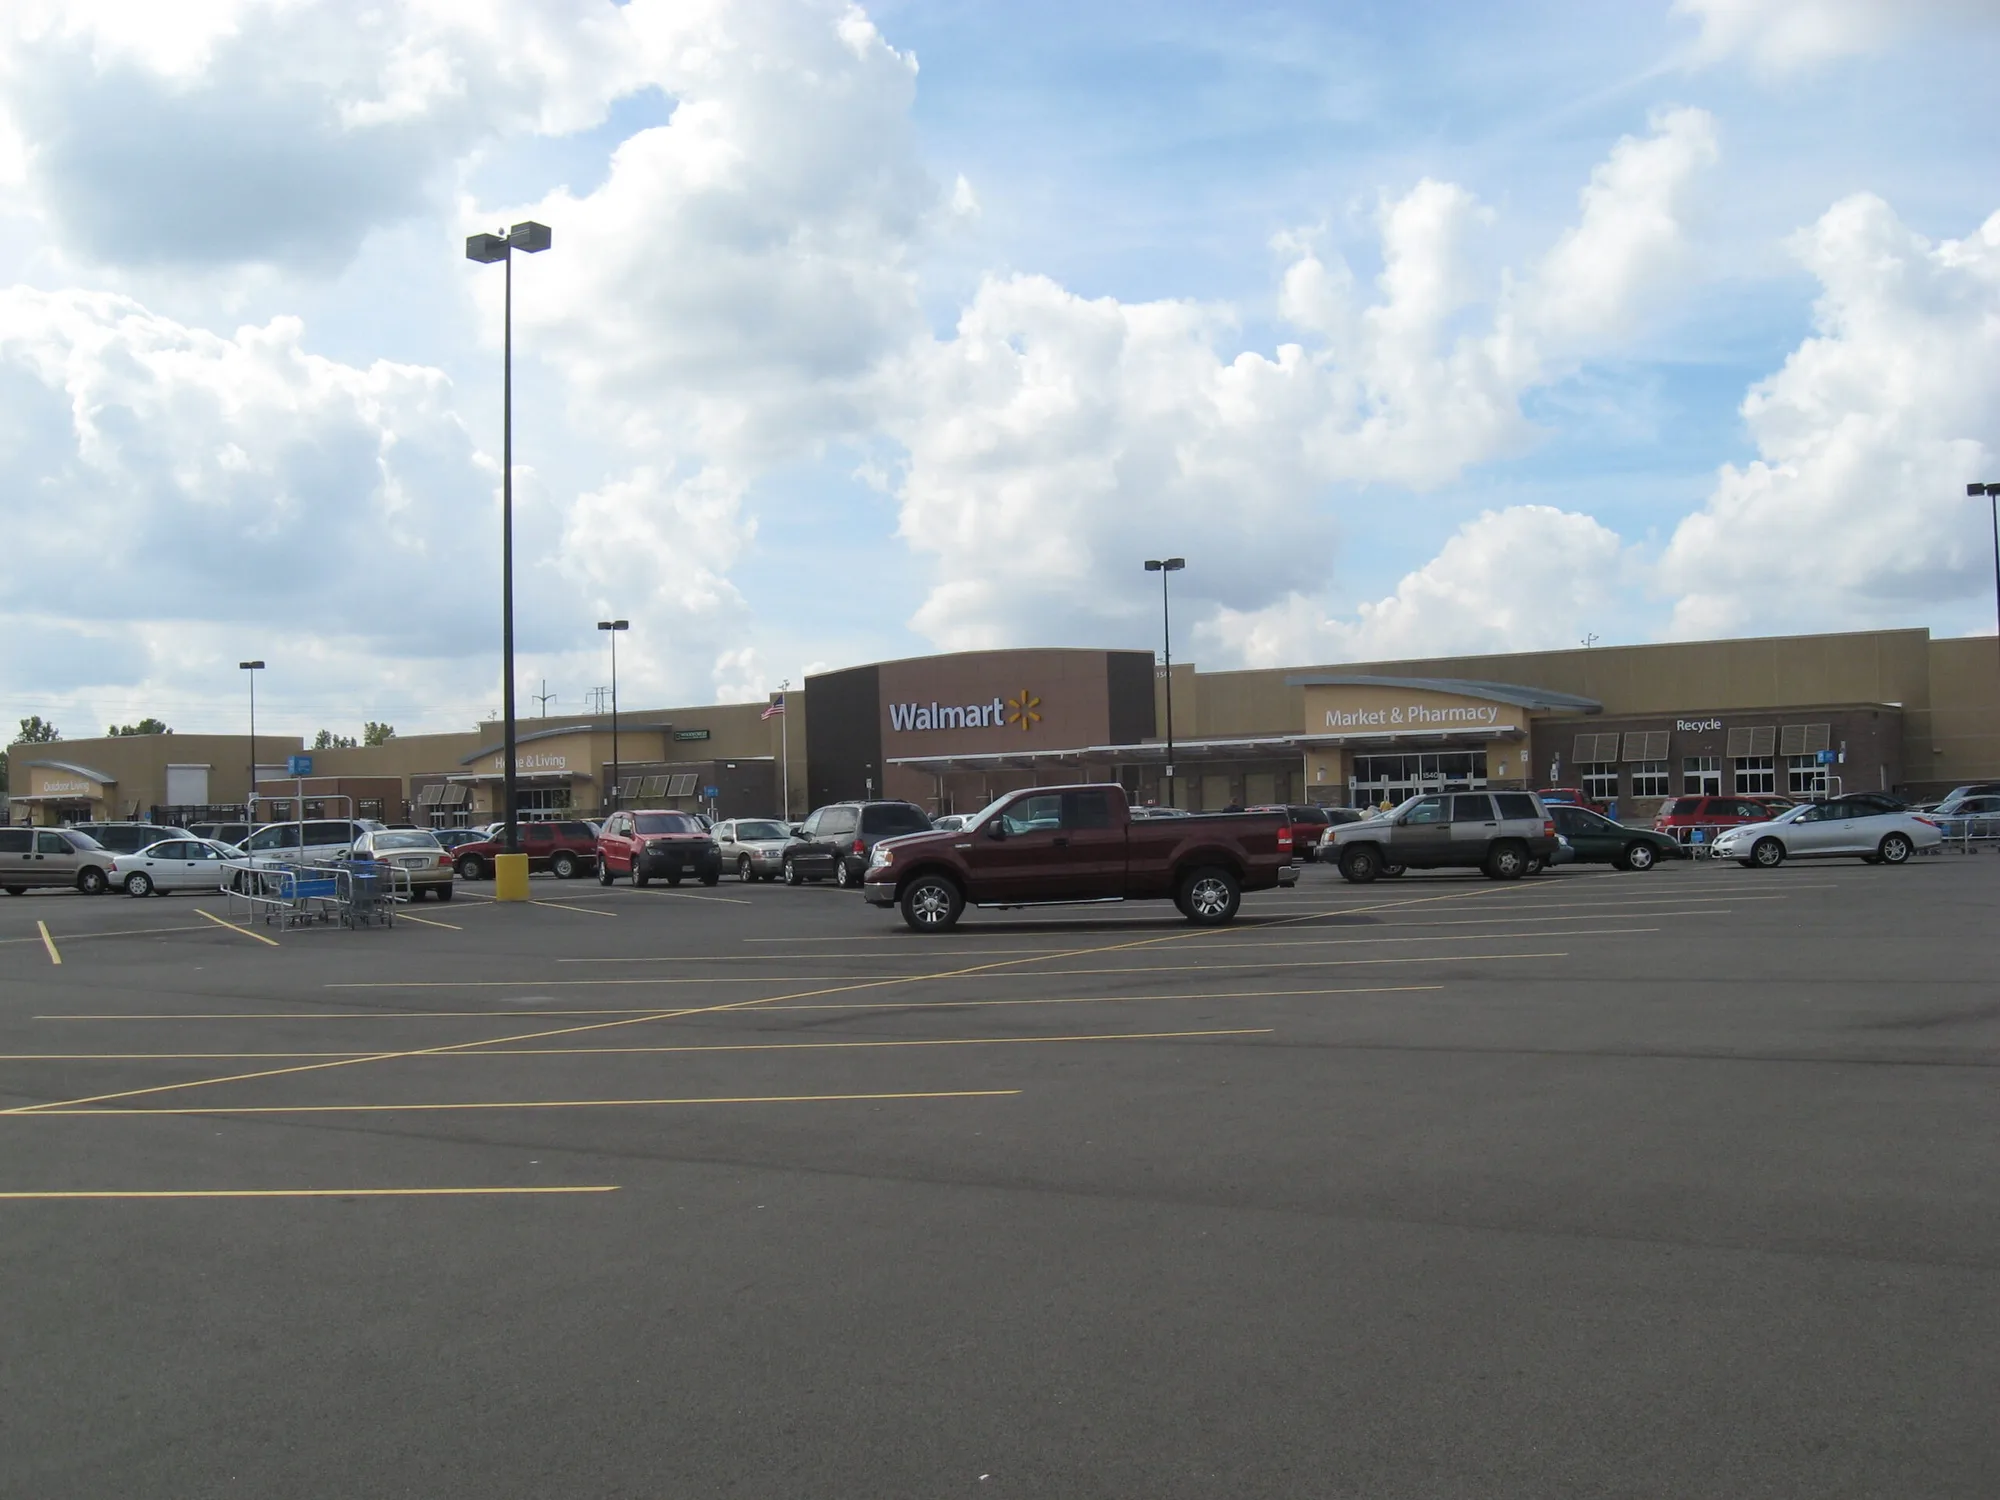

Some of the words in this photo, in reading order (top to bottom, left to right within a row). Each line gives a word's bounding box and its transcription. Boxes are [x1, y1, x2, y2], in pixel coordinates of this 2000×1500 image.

[889, 698, 1005, 731] Walmart
[1326, 708, 1386, 726] Market
[1390, 706, 1404, 724] &
[1408, 704, 1498, 724] Pharmacy
[1676, 718, 1722, 734] Recycle
[495, 756, 525, 769] He
[526, 755, 534, 768] &
[535, 753, 566, 769] Living
[43, 781, 70, 792] Outdoor
[70, 780, 89, 793] Living
